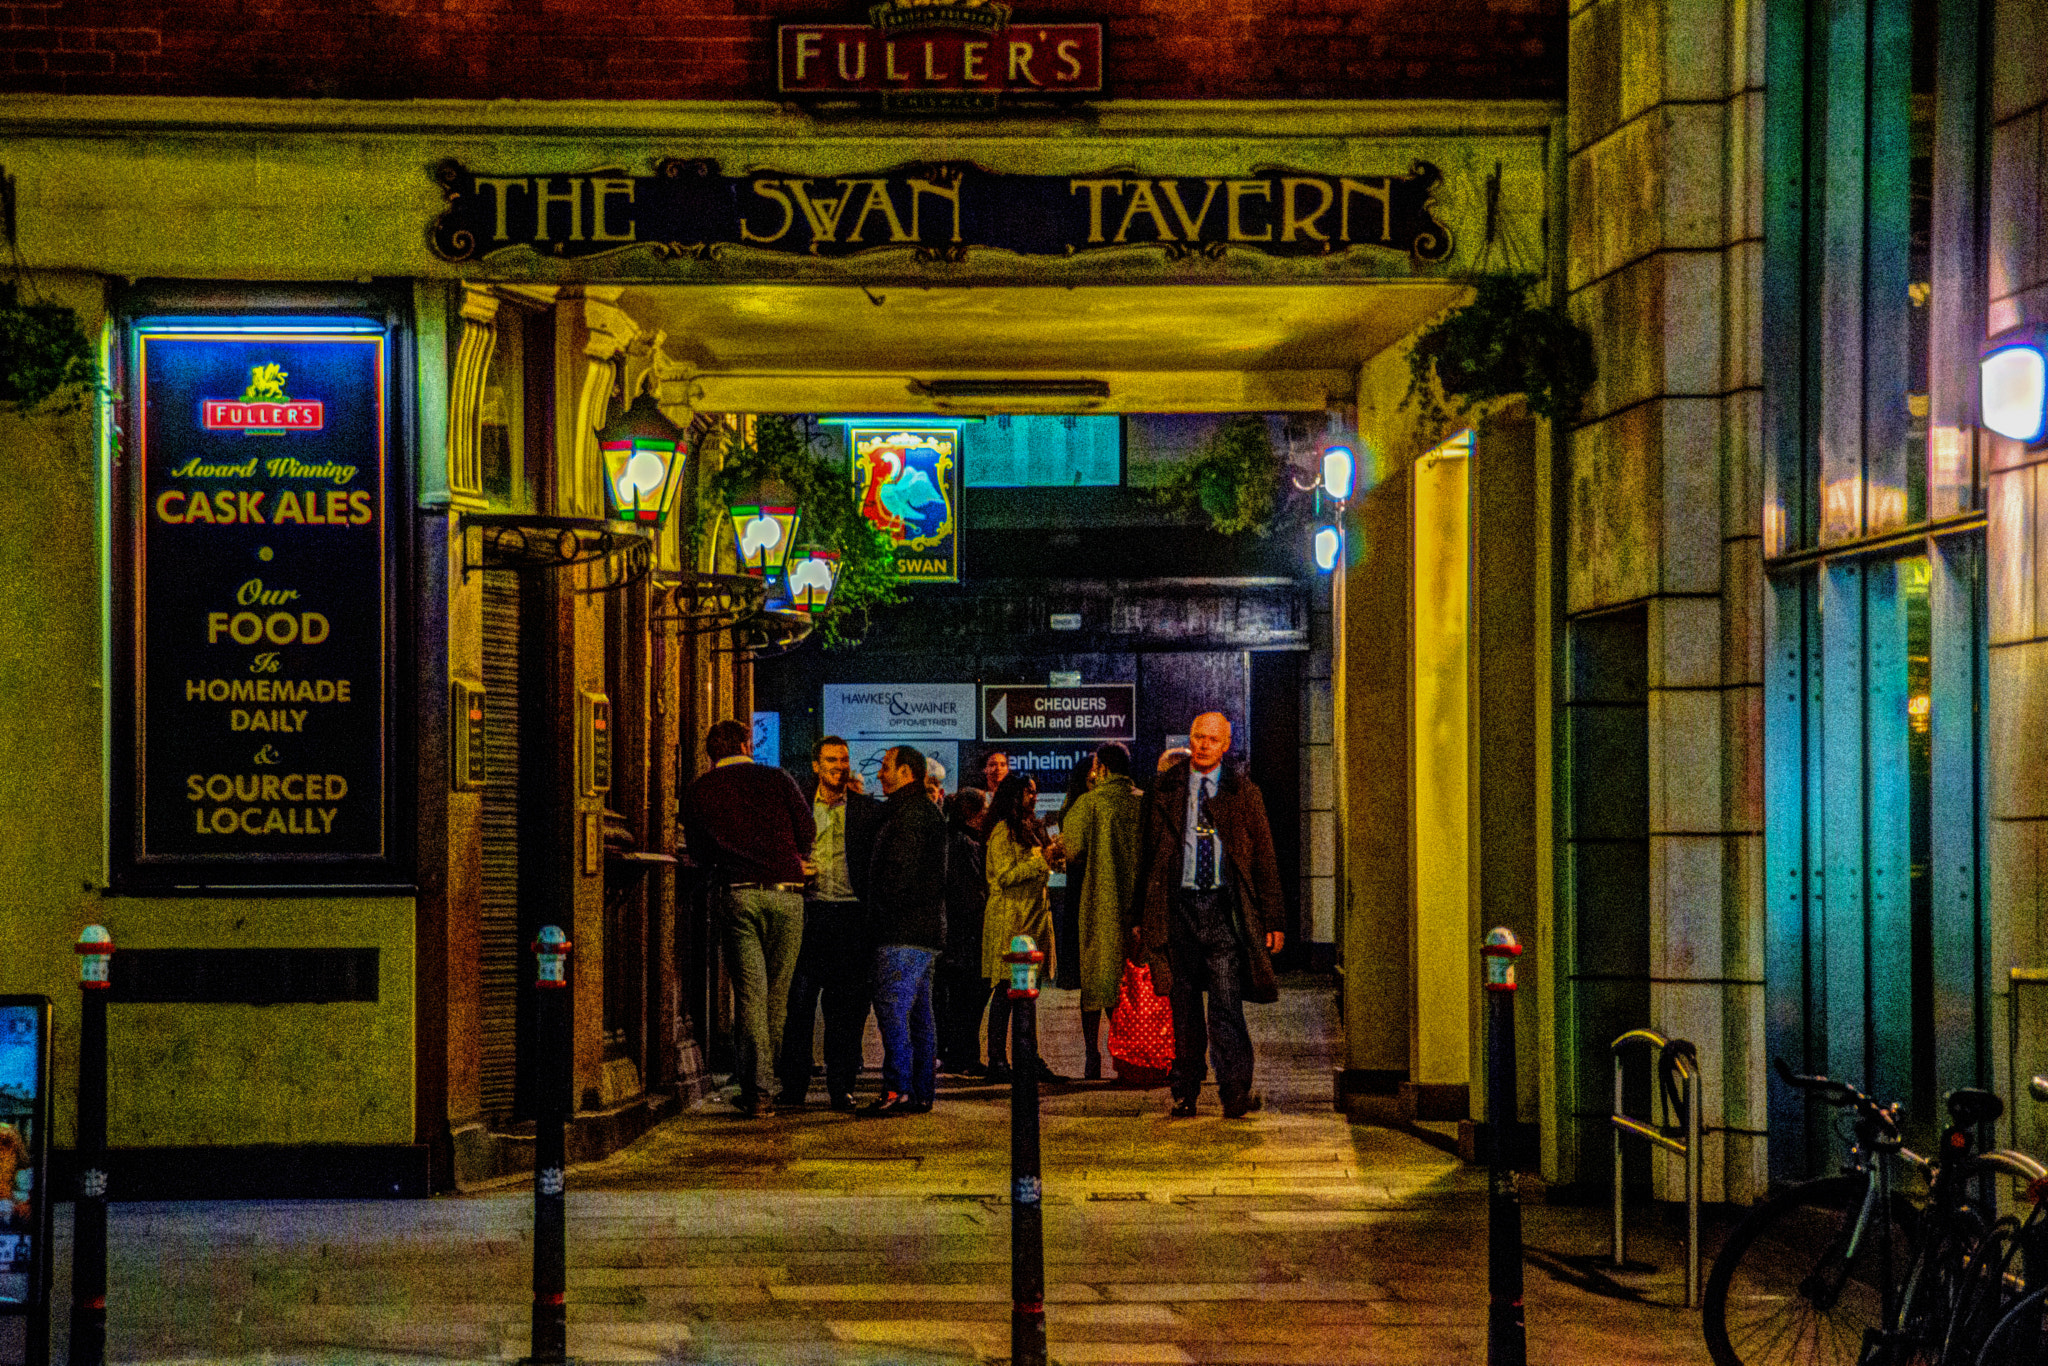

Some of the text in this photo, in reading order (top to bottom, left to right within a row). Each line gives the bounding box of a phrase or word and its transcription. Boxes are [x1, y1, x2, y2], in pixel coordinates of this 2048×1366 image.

[796, 31, 1081, 86] FULLER'S
[475, 172, 1391, 242] THE SWAN TAVERN
[216, 405, 313, 424] FULLER'S
[171, 457, 360, 485] Award Winning
[156, 490, 372, 524] CASK ALES
[897, 559, 948, 574] SWAN
[236, 578, 300, 605] Our
[207, 611, 330, 645] FOOD
[250, 651, 281, 673] Is
[186, 679, 351, 702] HOMEMADE
[841, 692, 958, 716] HAWKES & WAINER
[1034, 697, 1107, 712] CHEQUERS
[230, 709, 308, 732] DAILY
[1015, 715, 1126, 729] HAIR and BEAUTY
[253, 744, 281, 765] &
[1007, 751, 1073, 769] enheim
[186, 774, 348, 801] SOURCED
[196, 807, 337, 835] LOCALLY
